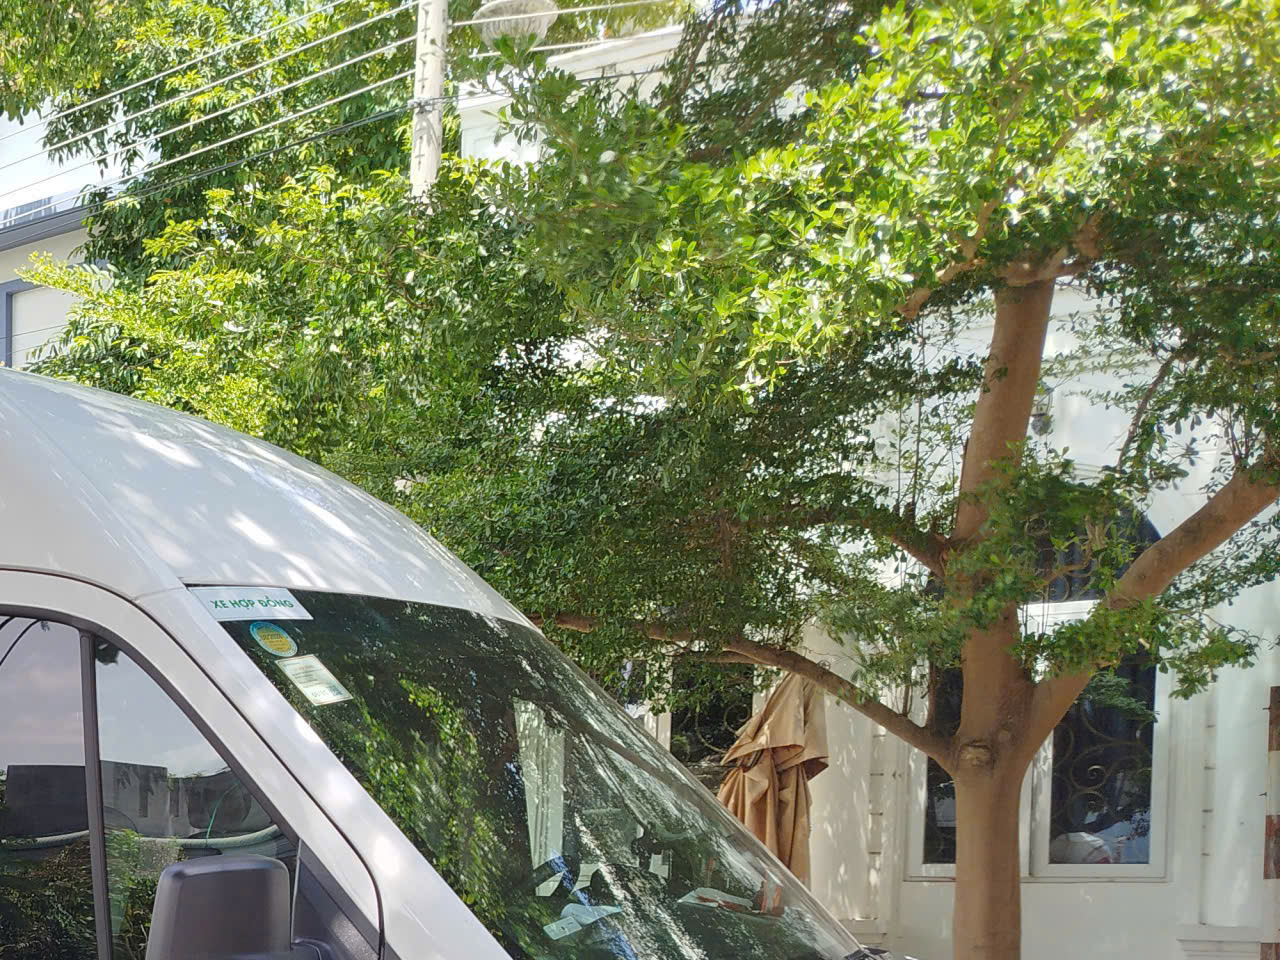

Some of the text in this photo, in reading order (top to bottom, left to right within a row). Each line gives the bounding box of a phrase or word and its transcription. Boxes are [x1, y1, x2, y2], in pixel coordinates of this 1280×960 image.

[210, 594, 294, 610] XE HỢP ĐỒNG
